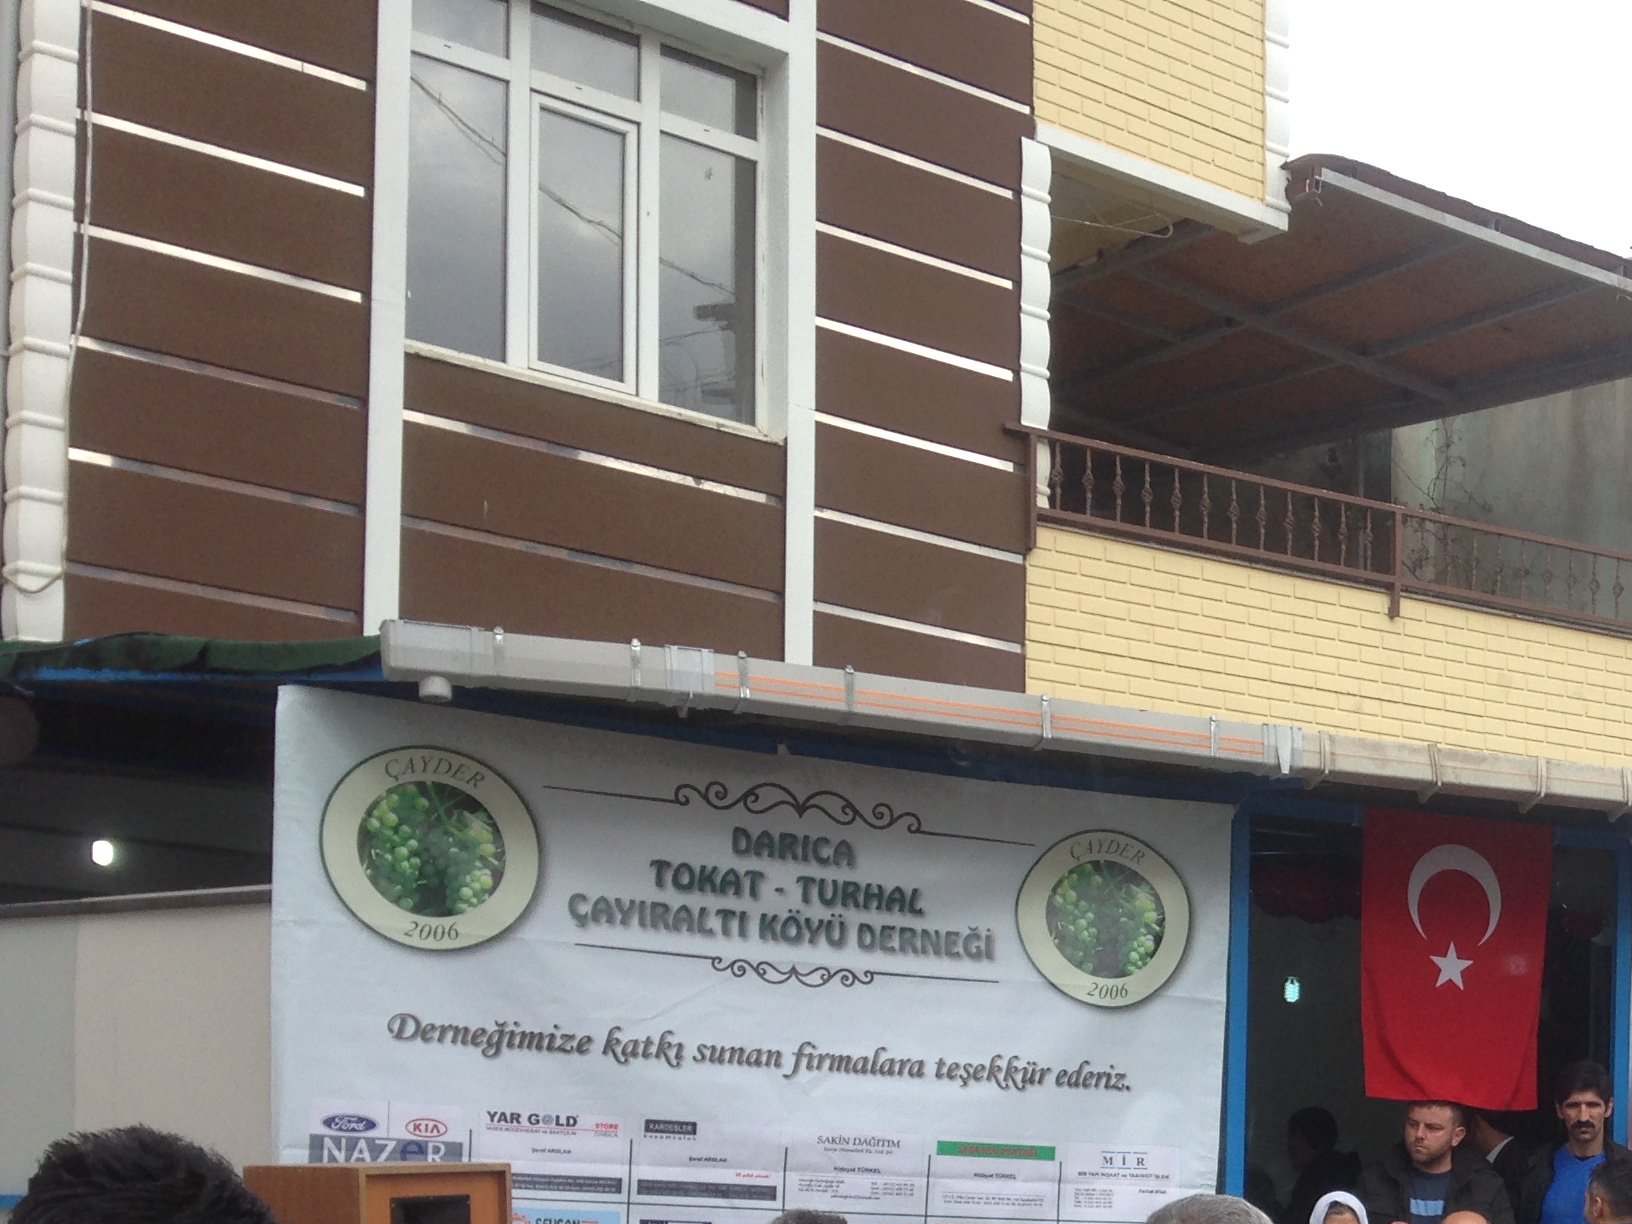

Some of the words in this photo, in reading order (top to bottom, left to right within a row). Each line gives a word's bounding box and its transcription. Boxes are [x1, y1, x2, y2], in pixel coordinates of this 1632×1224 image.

[383, 755, 487, 790] ÇAYDER
[730, 826, 856, 868] DARICA
[1070, 841, 1146, 864] ÇAYDER
[649, 858, 766, 900] TOKAT
[799, 875, 924, 916] TURHAL
[403, 921, 460, 942] 2006
[568, 893, 748, 940] ÇAYIRALTI
[757, 910, 846, 950] KÖYÜ
[856, 924, 997, 961] DERNEĞİ
[1086, 982, 1129, 1001] 2006
[387, 1012, 594, 1059] Derneğimize
[601, 1025, 686, 1069] katkı
[692, 1039, 783, 1070] sunan
[782, 1041, 925, 1080] firmalara
[934, 1053, 1050, 1092] teşekkür
[1054, 1060, 1132, 1092] ederiz.
[330, 1116, 368, 1131] Ford
[411, 1122, 443, 1135] KIA
[486, 1110, 522, 1125] YAR
[816, 1134, 850, 1146] SAKİN
[852, 1137, 901, 1149] DAĞITIM
